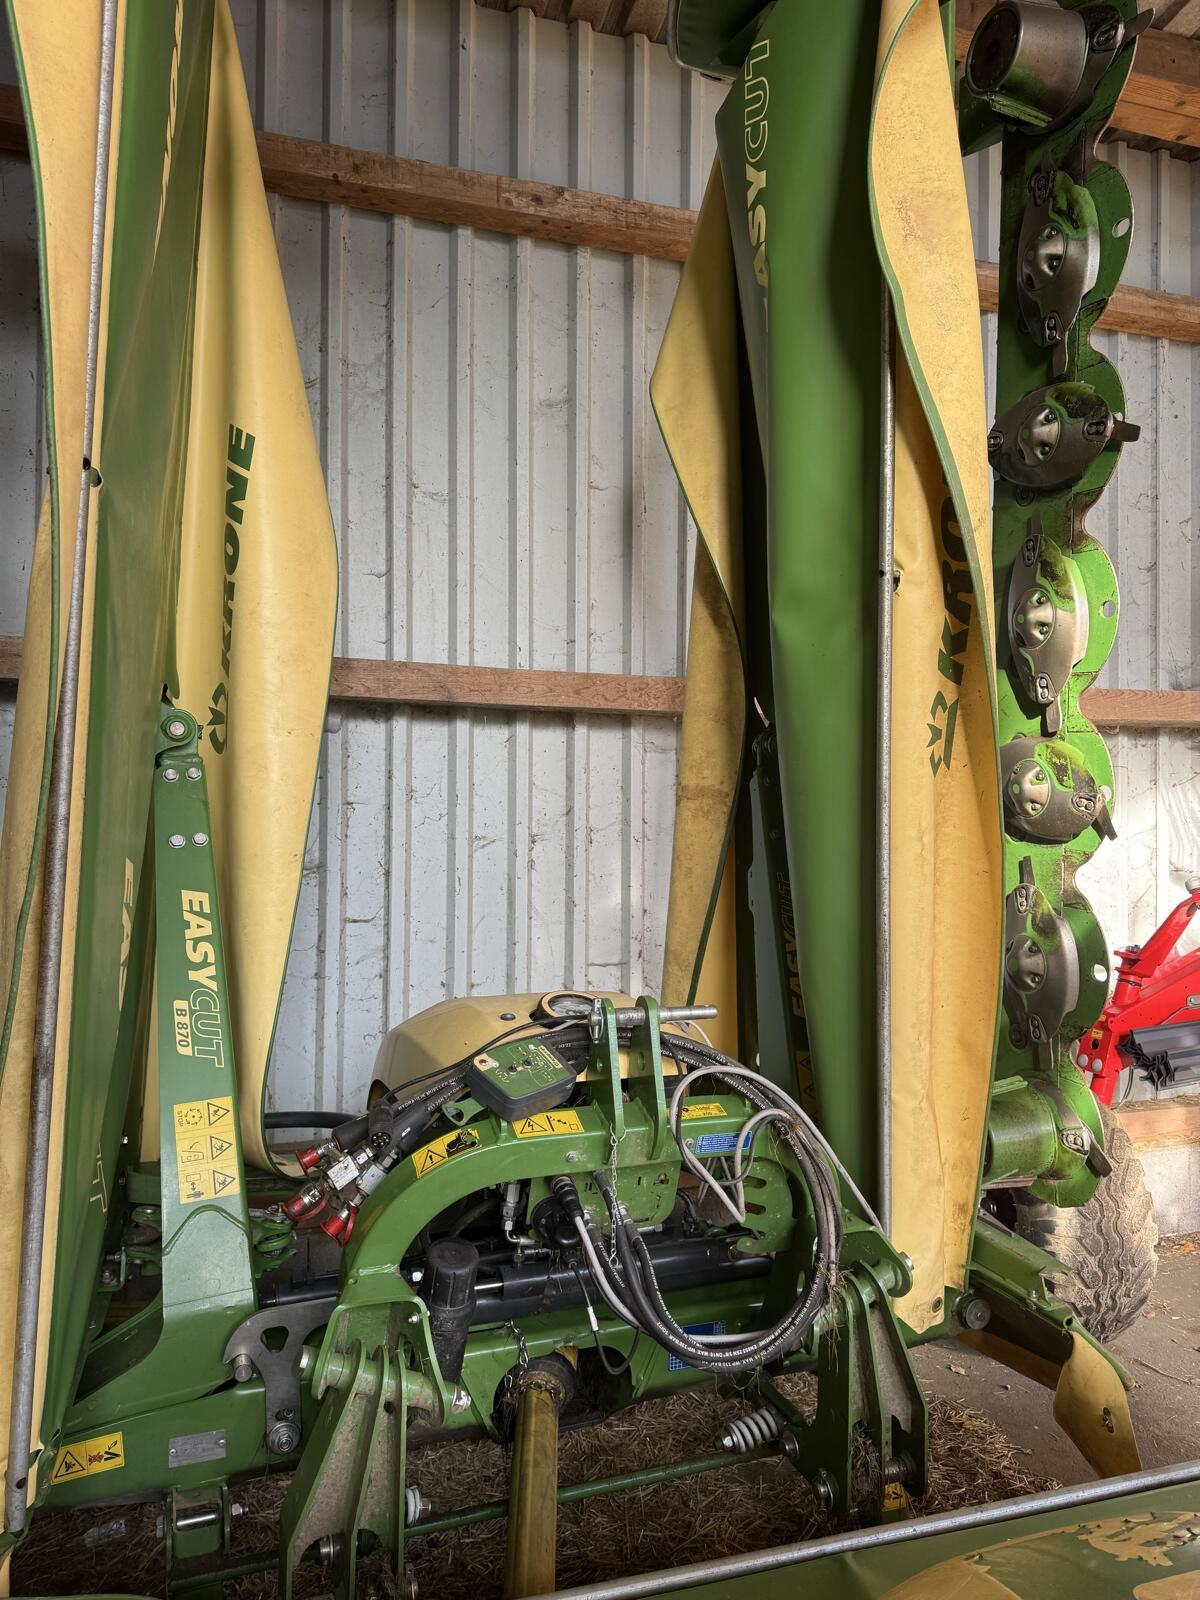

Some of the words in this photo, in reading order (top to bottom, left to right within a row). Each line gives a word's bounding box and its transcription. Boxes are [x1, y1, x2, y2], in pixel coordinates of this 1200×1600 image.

[744, 39, 770, 333] ASYCUT
[221, 423, 256, 679] KRONE
[176, 1007, 188, 1018] B
[177, 1023, 191, 1049] 870
[181, 889, 225, 1068] EASYCUT
